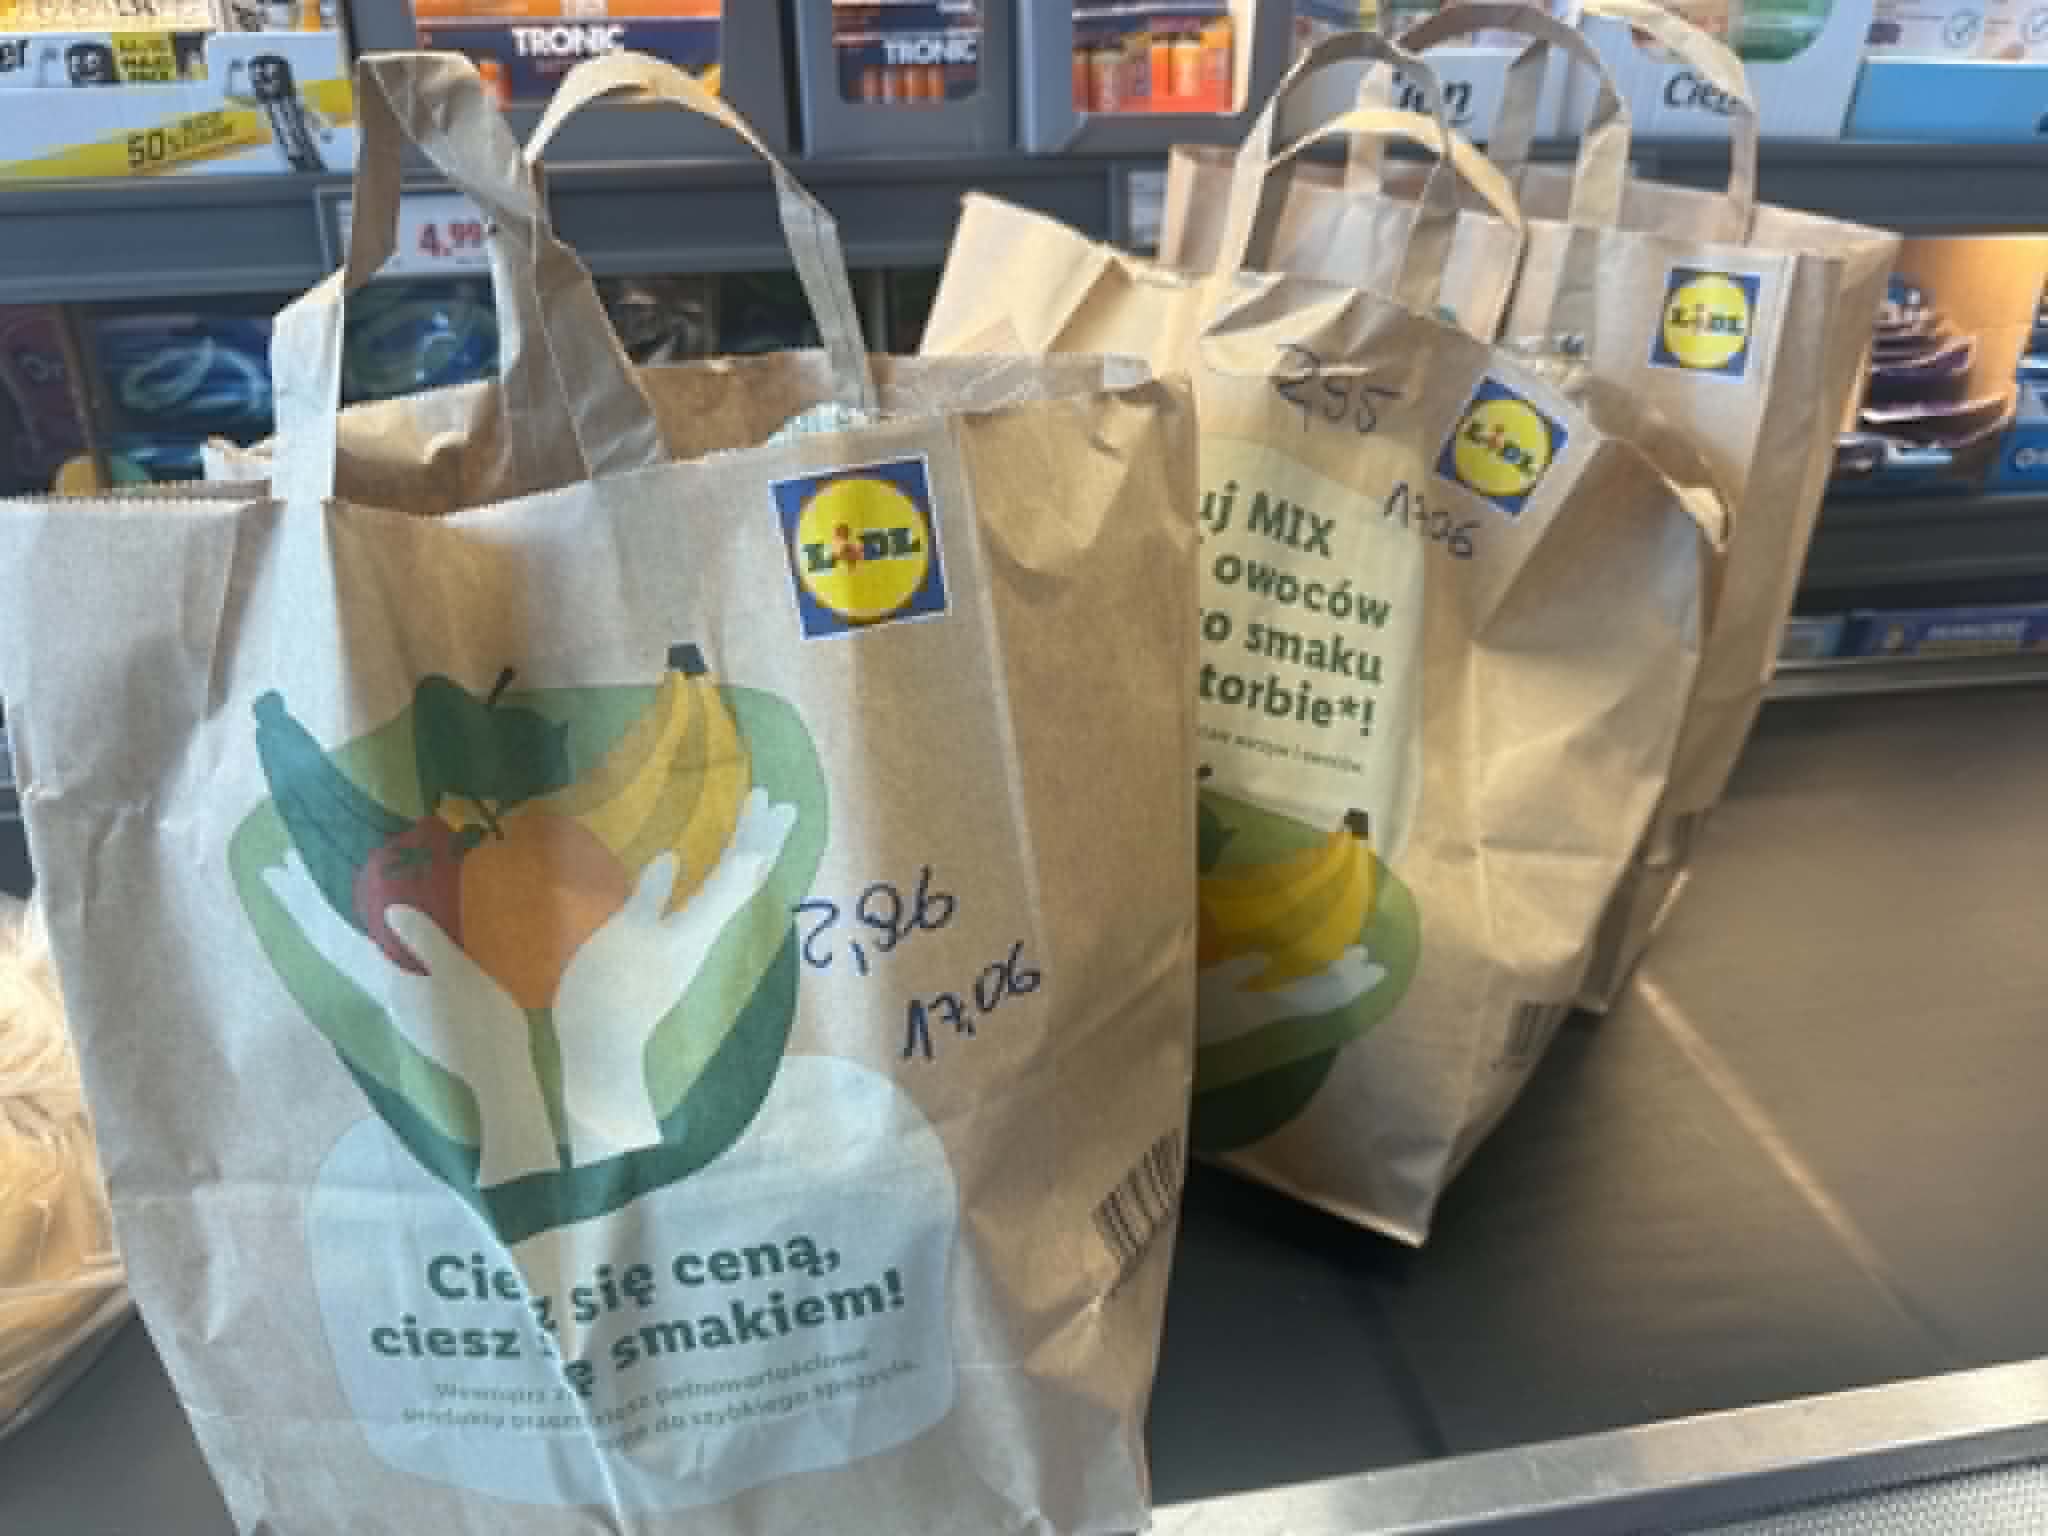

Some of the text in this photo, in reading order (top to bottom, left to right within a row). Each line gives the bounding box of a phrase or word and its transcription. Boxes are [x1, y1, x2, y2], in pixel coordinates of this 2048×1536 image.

[513, 24, 626, 57] TRONIC
[884, 38, 977, 65] TRONIC
[1248, 492, 1335, 558] MIX
[1213, 553, 1392, 628] owoców
[1244, 622, 1383, 688] smaku
[571, 1263, 654, 1322] się
[672, 1234, 841, 1289] ceną,
[371, 1314, 521, 1358] ciesz
[610, 1268, 906, 1371] smakiem!
